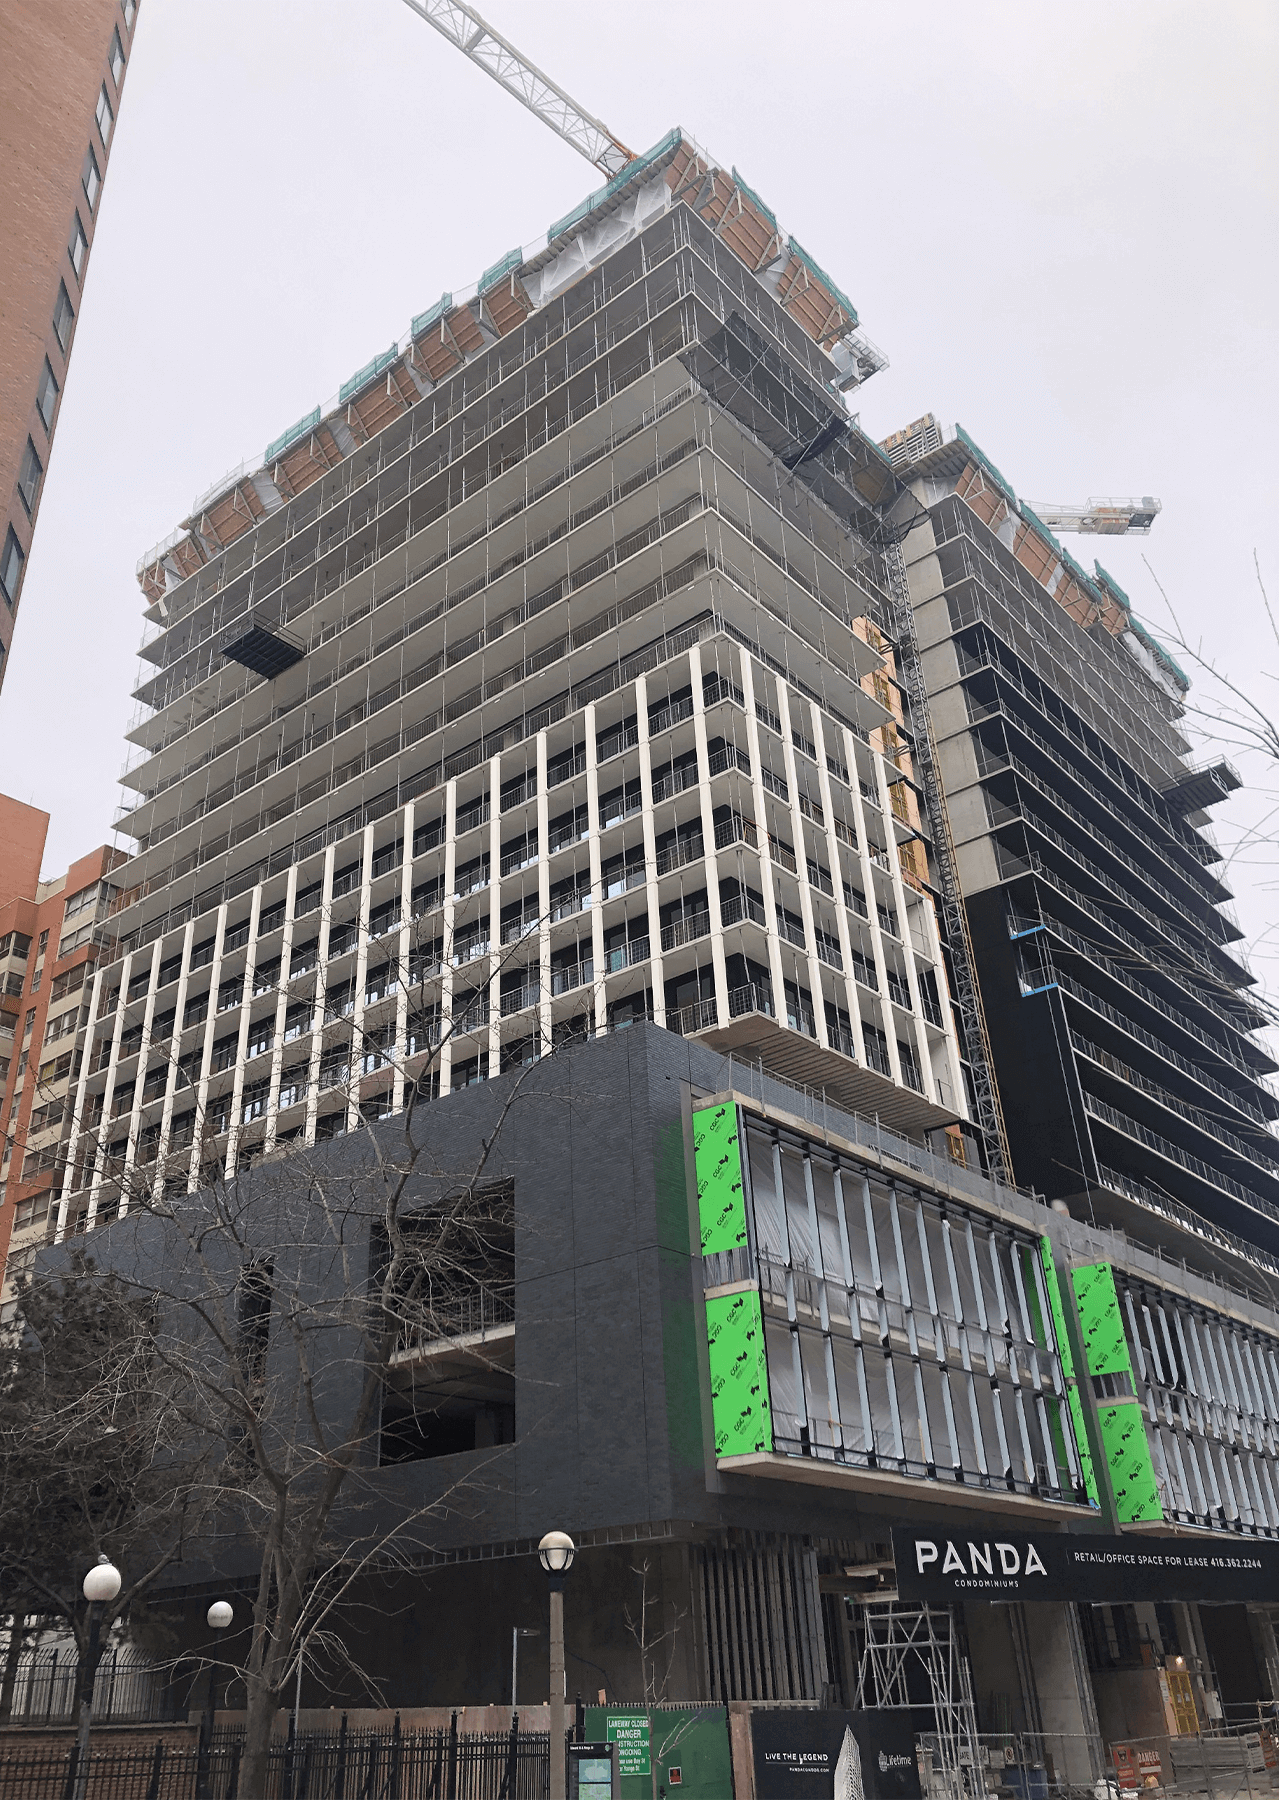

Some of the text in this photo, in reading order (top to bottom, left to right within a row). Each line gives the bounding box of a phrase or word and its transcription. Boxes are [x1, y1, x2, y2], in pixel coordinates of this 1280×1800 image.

[915, 1540, 1048, 1576] PANDA
[1074, 1552, 1262, 1568] RETAIL/OFFICE SPACE FOR LEASE 416.362.2244
[954, 1580, 1019, 1588] CONDOMINIUMS
[616, 1730, 642, 1738] DANGER
[799, 1754, 829, 1764] LEGEND
